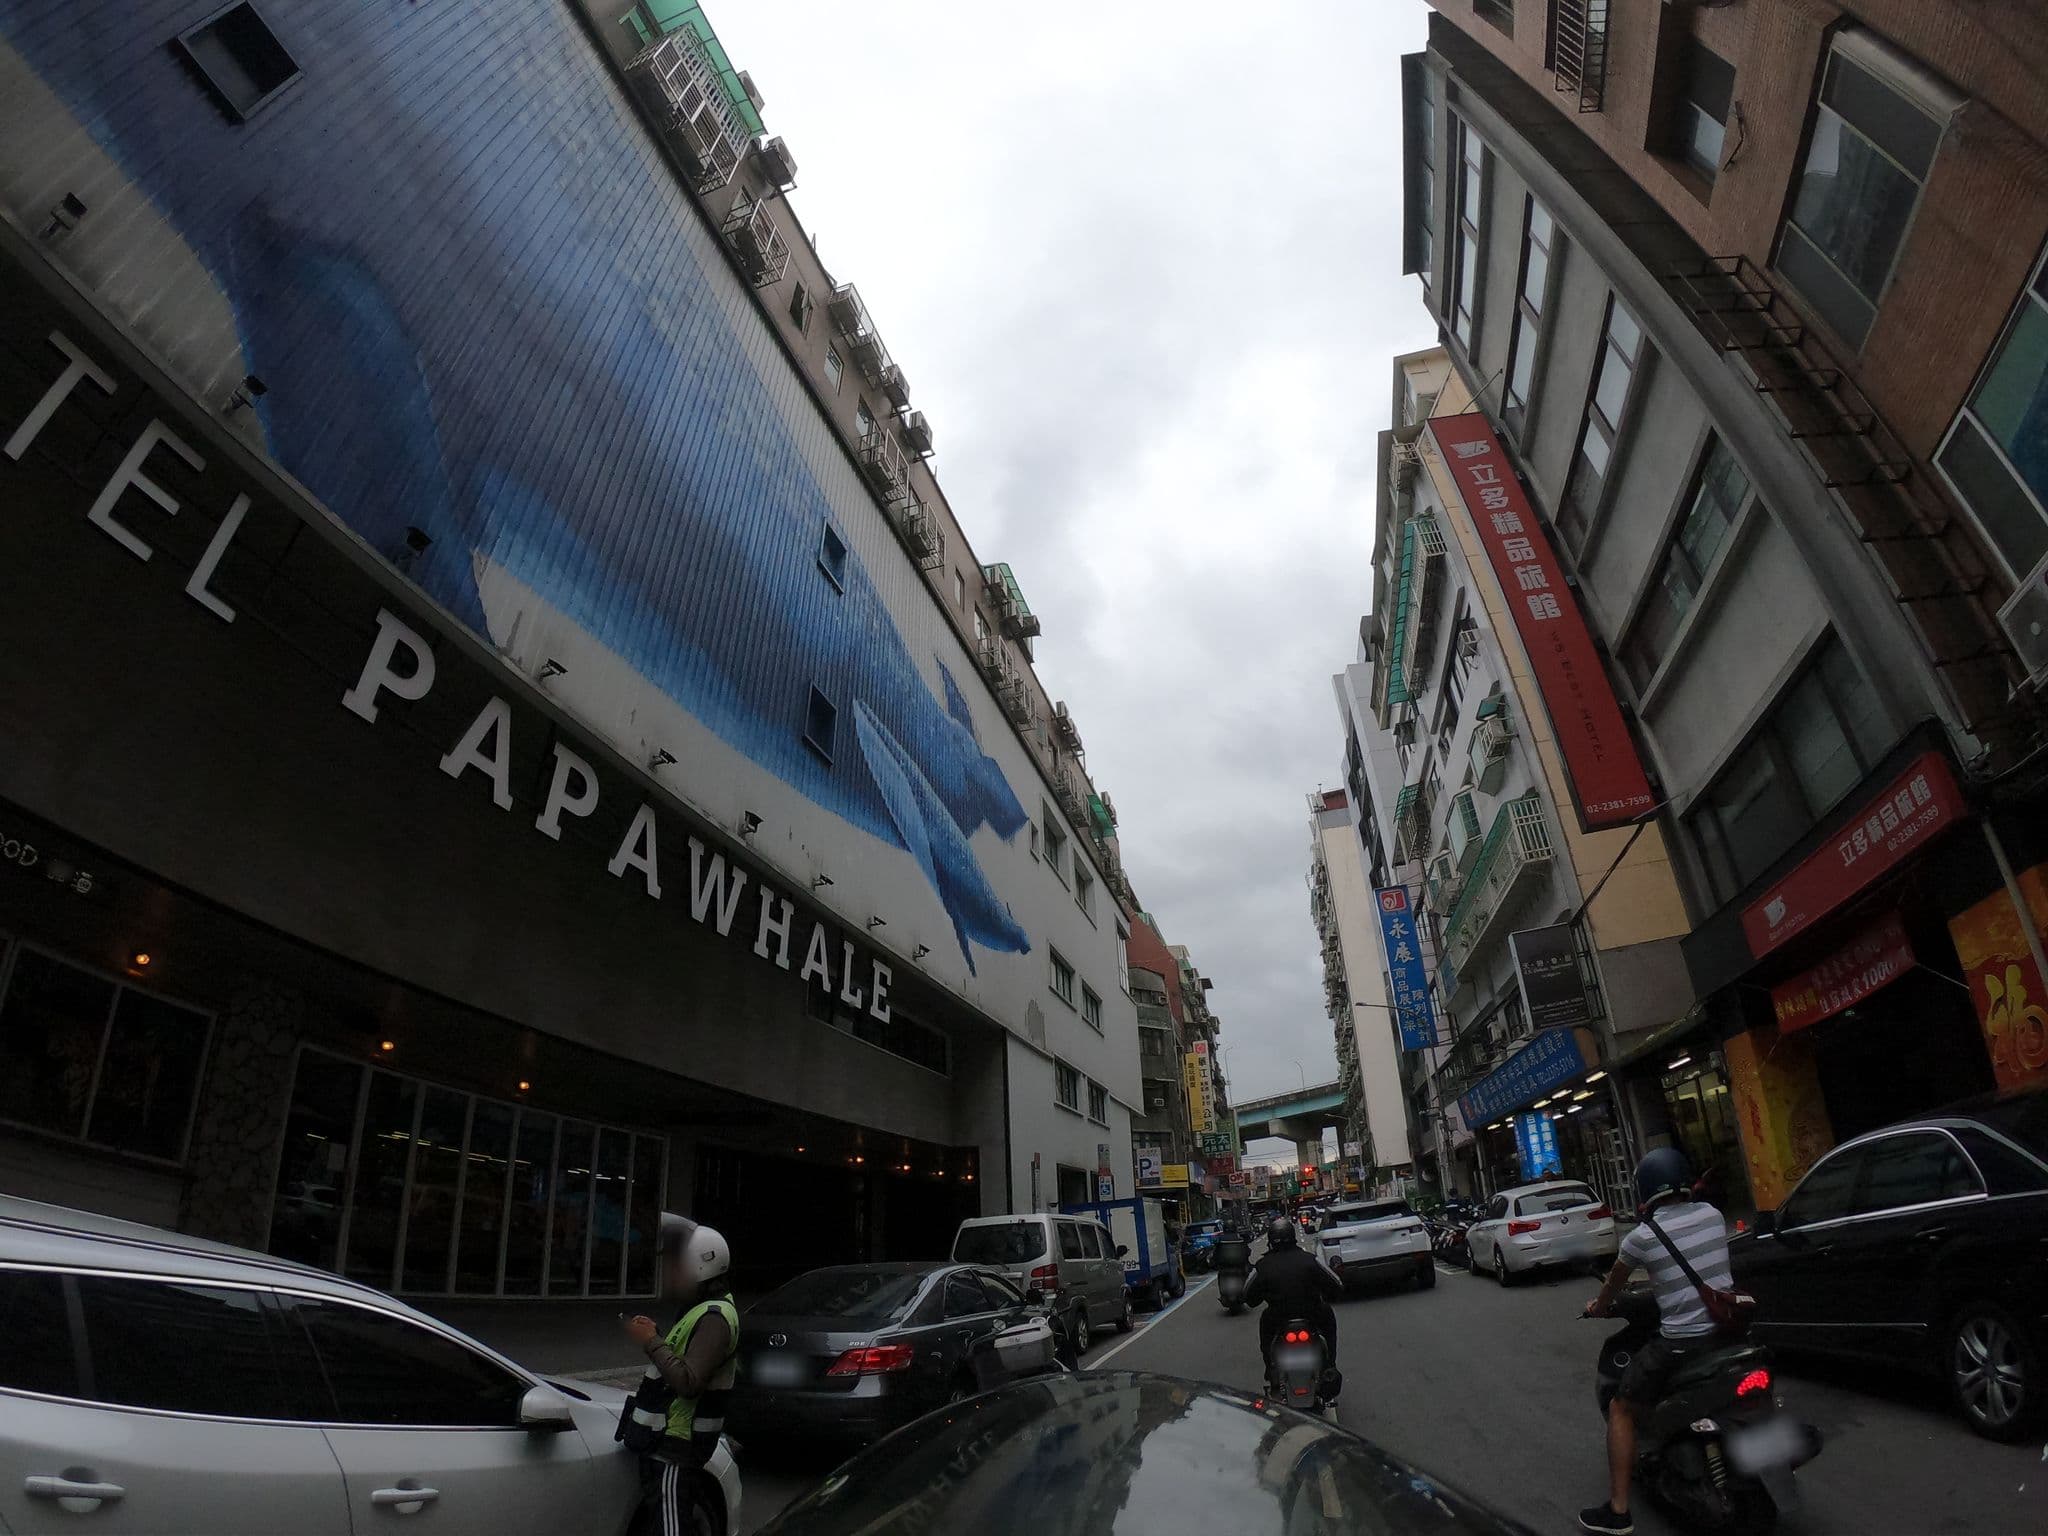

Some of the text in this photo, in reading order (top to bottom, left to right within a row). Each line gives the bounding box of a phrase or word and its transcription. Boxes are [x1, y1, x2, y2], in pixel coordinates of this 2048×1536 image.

[1468, 463, 1563, 621] 立多精品旅館
[1586, 795, 1650, 814] 02-2381-7599
[1839, 774, 1932, 867] 立多精品旅館
[1388, 918, 1415, 963] 永展
